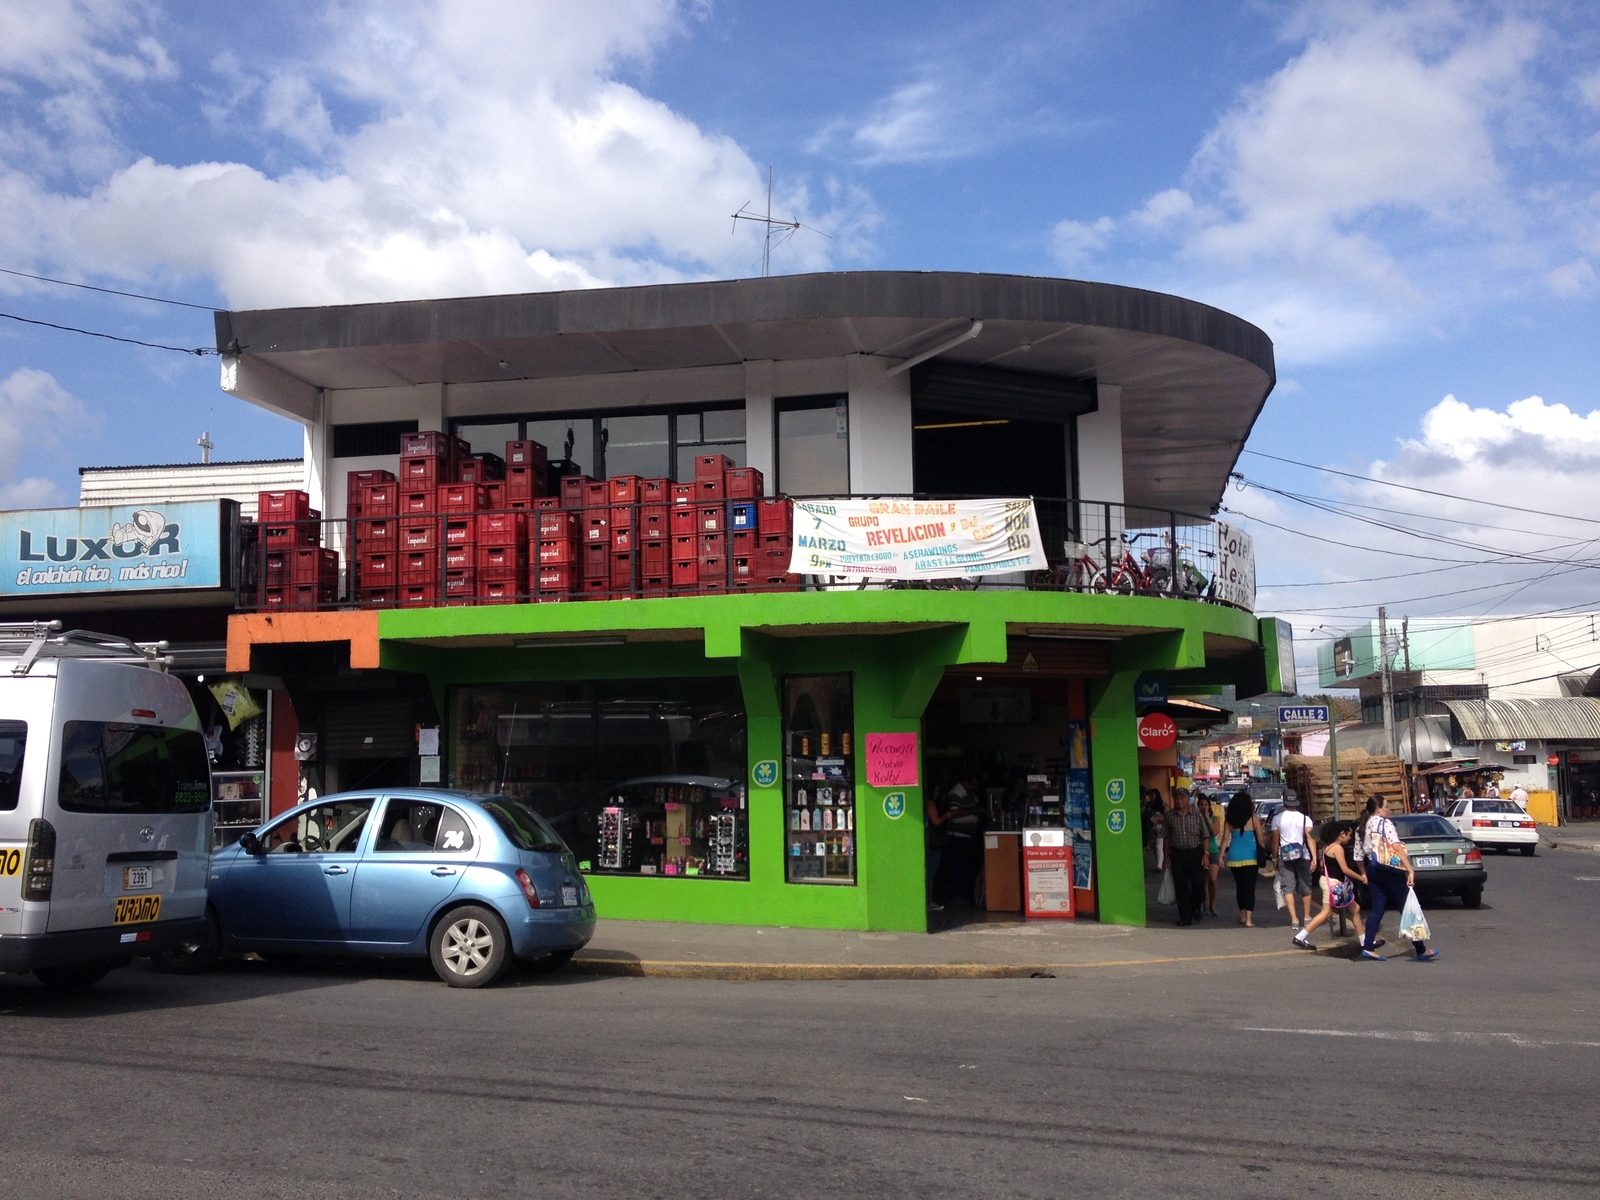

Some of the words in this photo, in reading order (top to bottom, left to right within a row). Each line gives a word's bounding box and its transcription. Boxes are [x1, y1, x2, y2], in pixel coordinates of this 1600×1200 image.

[869, 503, 911, 515] GRAN
[915, 503, 956, 516] BAILE
[813, 517, 822, 530] 7
[848, 516, 880, 528] GRUPO
[866, 522, 946, 547] REVELACION
[960, 515, 978, 530] DJ
[972, 525, 995, 542] CAT
[407, 535, 428, 547] Imperial
[798, 534, 847, 552] MARZO
[1007, 534, 1031, 552] RIO
[31, 565, 83, 585] colchón
[118, 562, 150, 581] más
[151, 559, 188, 579] rico!
[1283, 709, 1315, 719] CALLE
[1317, 709, 1324, 719] 2
[1141, 727, 1168, 737] Claro
[133, 872, 148, 884] 2391
